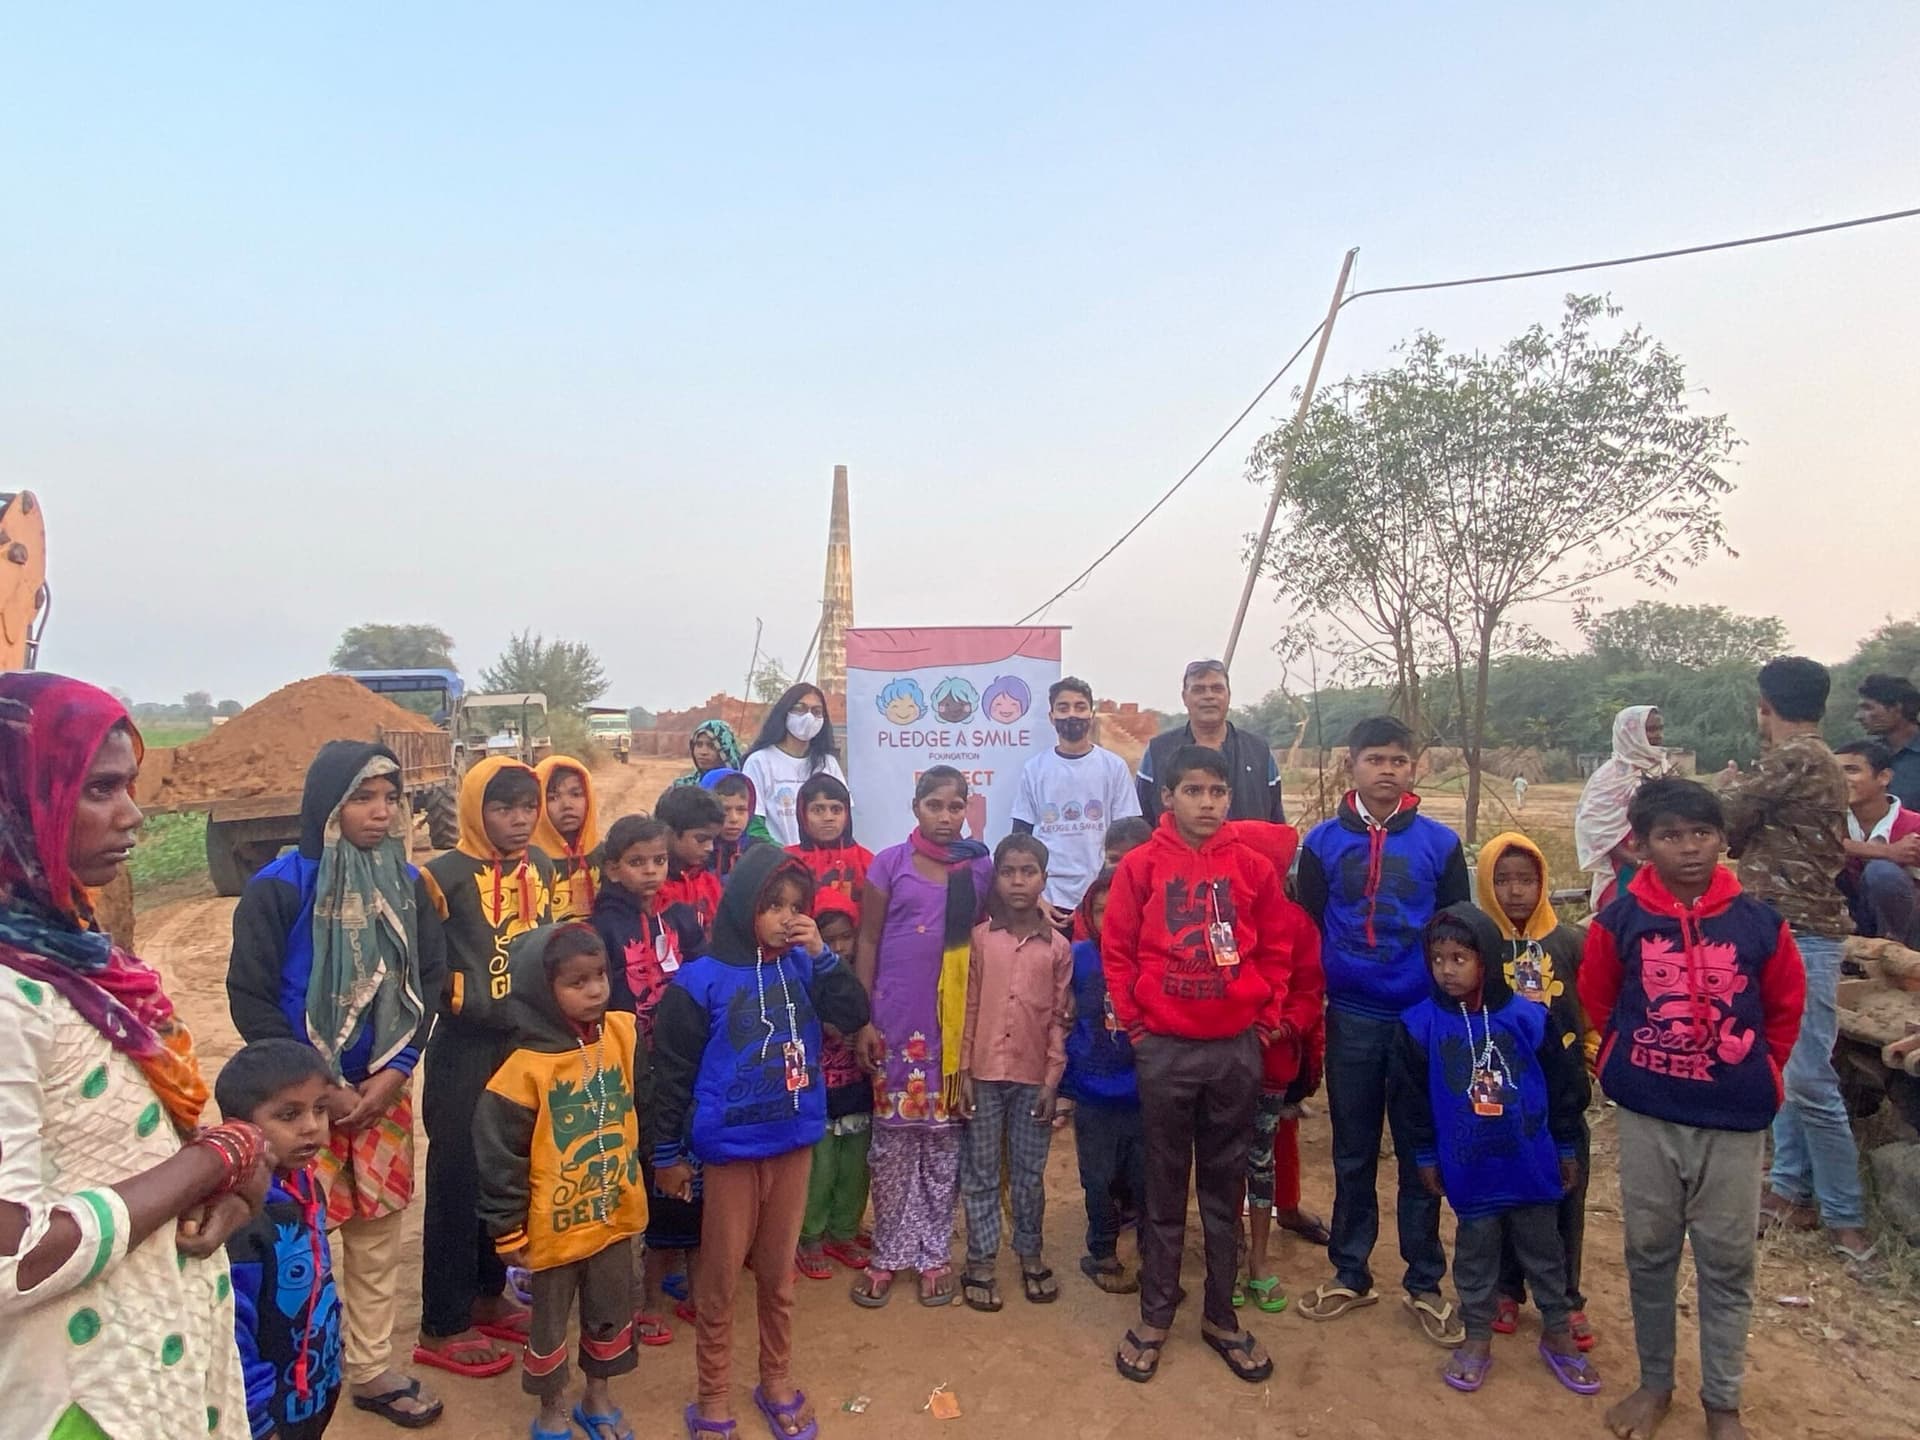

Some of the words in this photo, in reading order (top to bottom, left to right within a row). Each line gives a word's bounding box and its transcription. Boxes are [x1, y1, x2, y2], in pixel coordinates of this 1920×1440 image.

[878, 731, 950, 747] PLEDGE
[955, 730, 967, 746] A
[972, 729, 1030, 746] SMILE
[928, 752, 980, 761] FOUNDATION
[1630, 1044, 1716, 1082] GEEK
